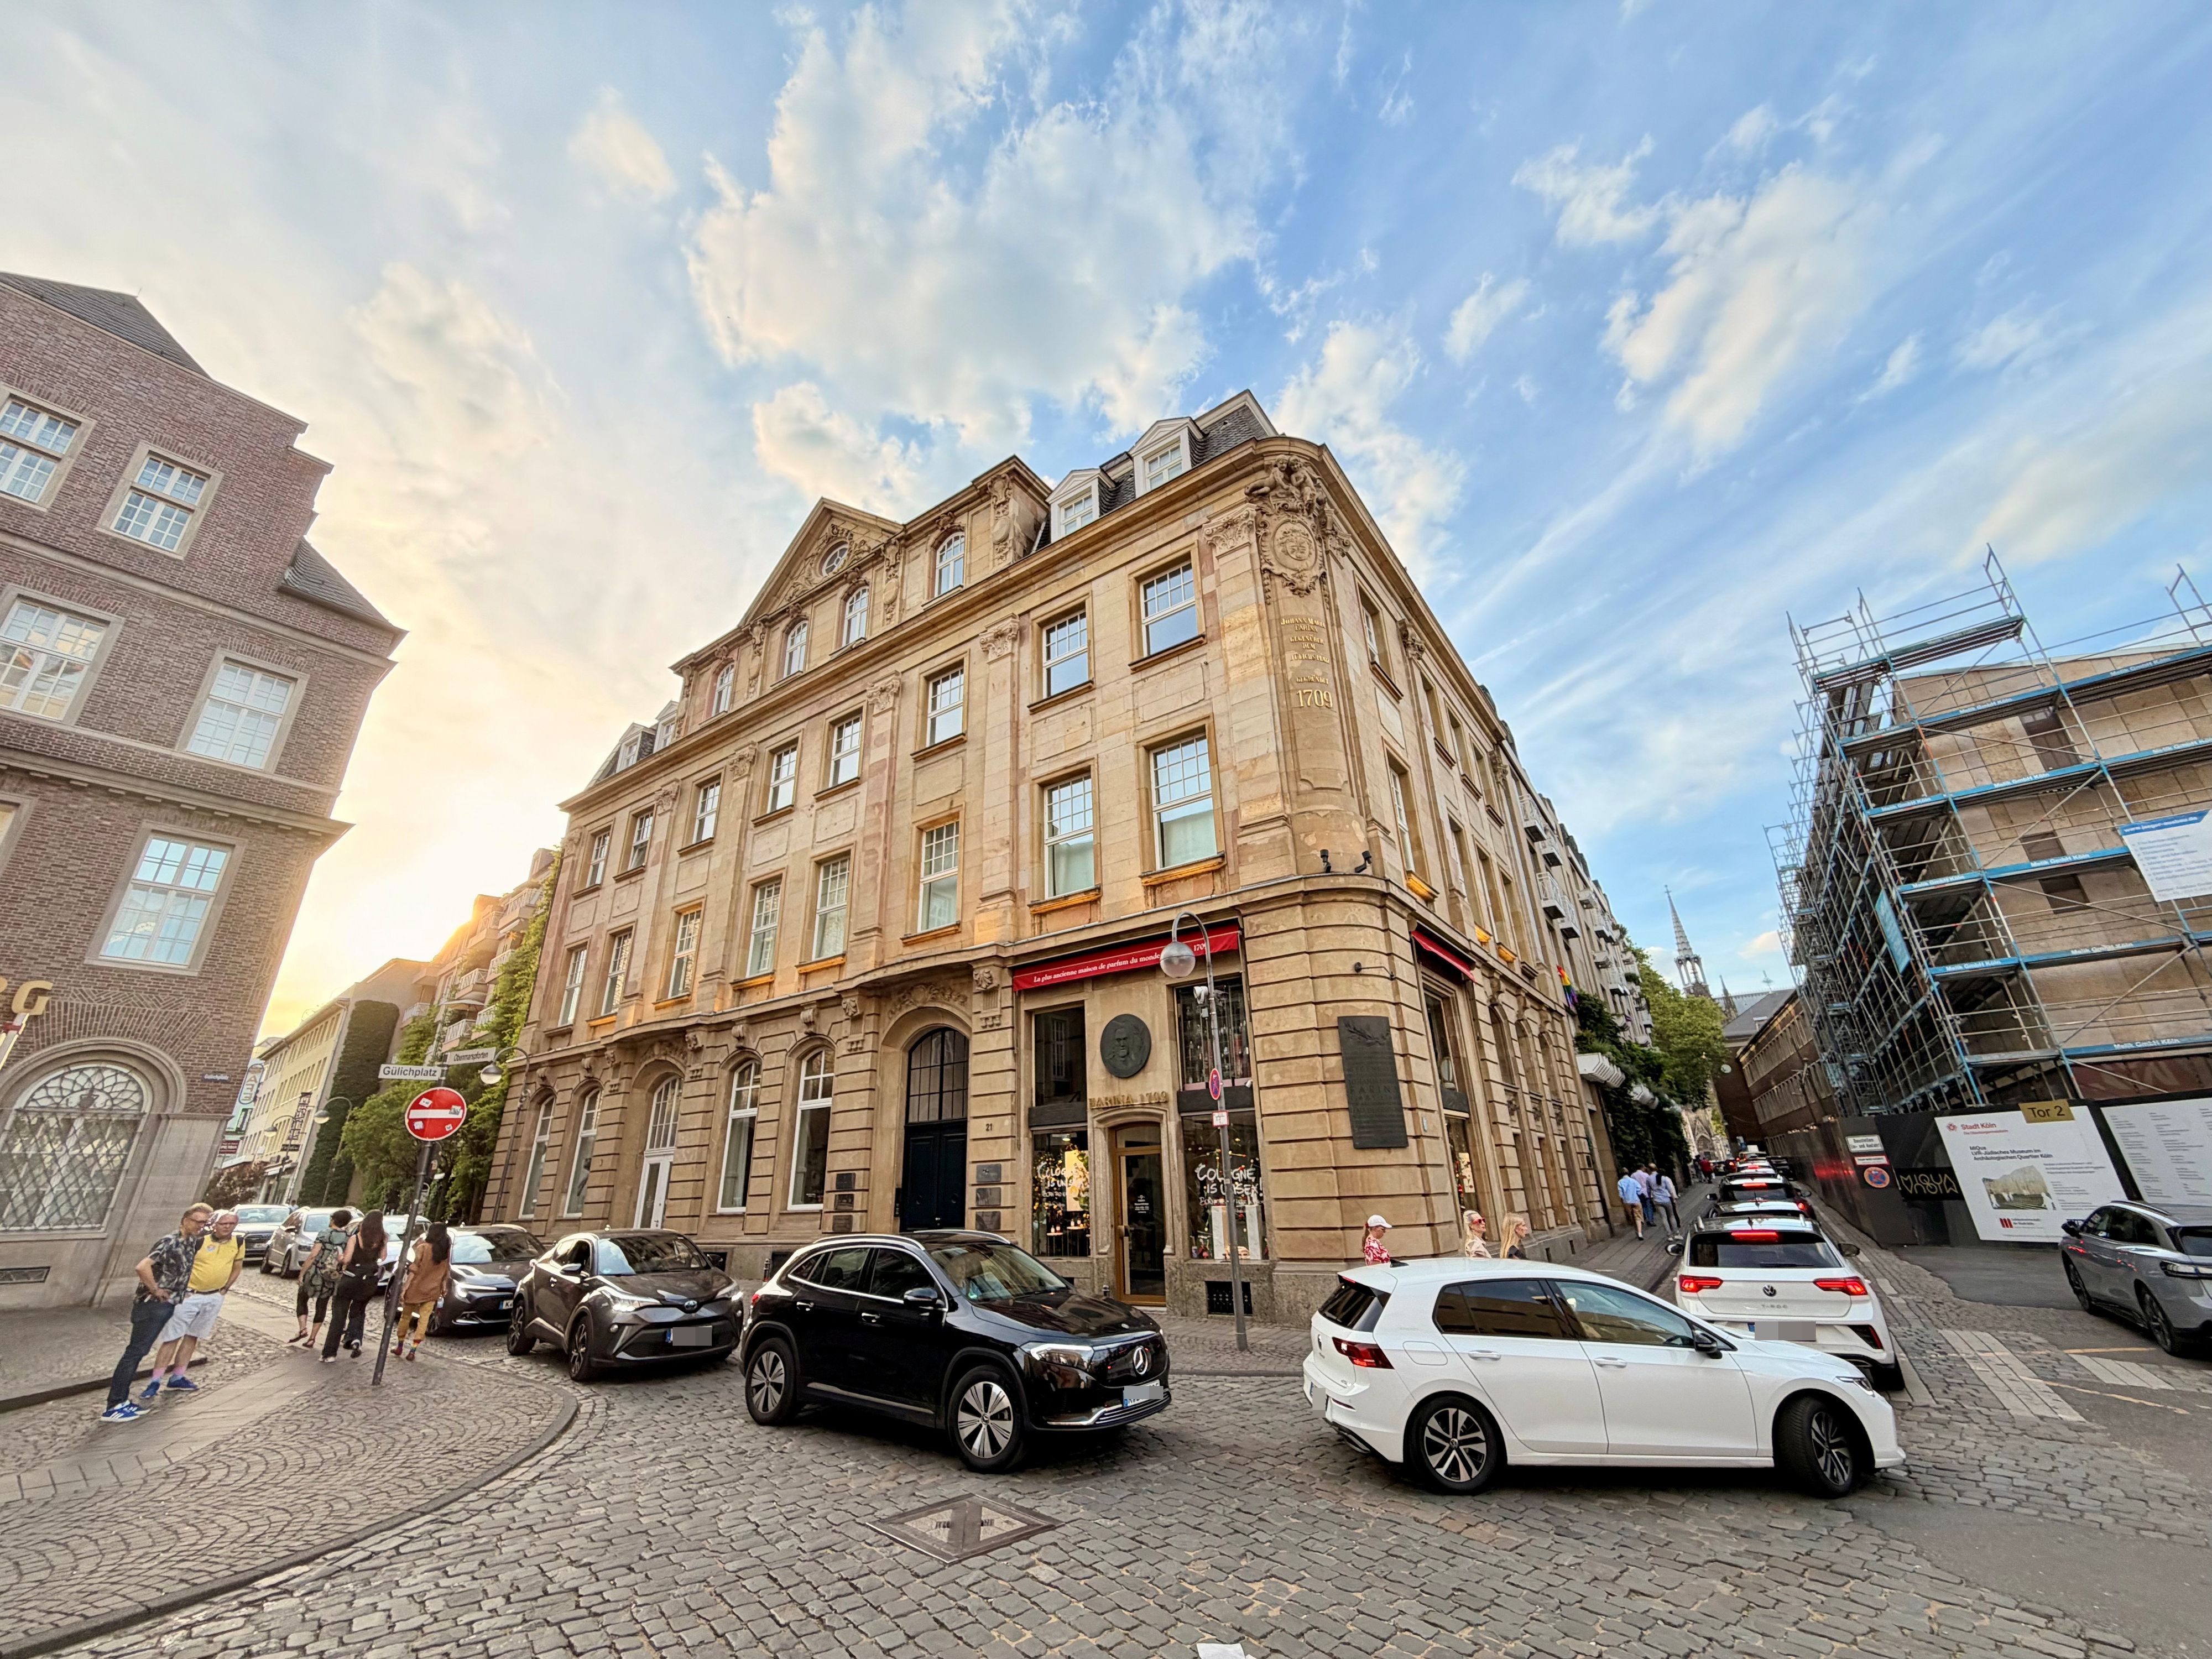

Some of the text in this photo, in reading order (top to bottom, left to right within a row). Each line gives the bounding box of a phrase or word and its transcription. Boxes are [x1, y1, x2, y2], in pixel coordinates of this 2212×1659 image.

[1296, 689, 1333, 708] 1709
[1041, 974, 1052, 982] plus
[1078, 966, 1098, 974] maison
[1107, 958, 1129, 969] parfum
[1139, 952, 1161, 962] monde
[453, 1051, 489, 1062] Obenmarspforten
[383, 1066, 437, 1079] Gülichplatz
[2028, 1105, 2065, 1118] Tor 2
[985, 1123, 993, 1131] 21
[1196, 1164, 1256, 1182] COLGNE
[1207, 1177, 1263, 1196] IS UISEX!
